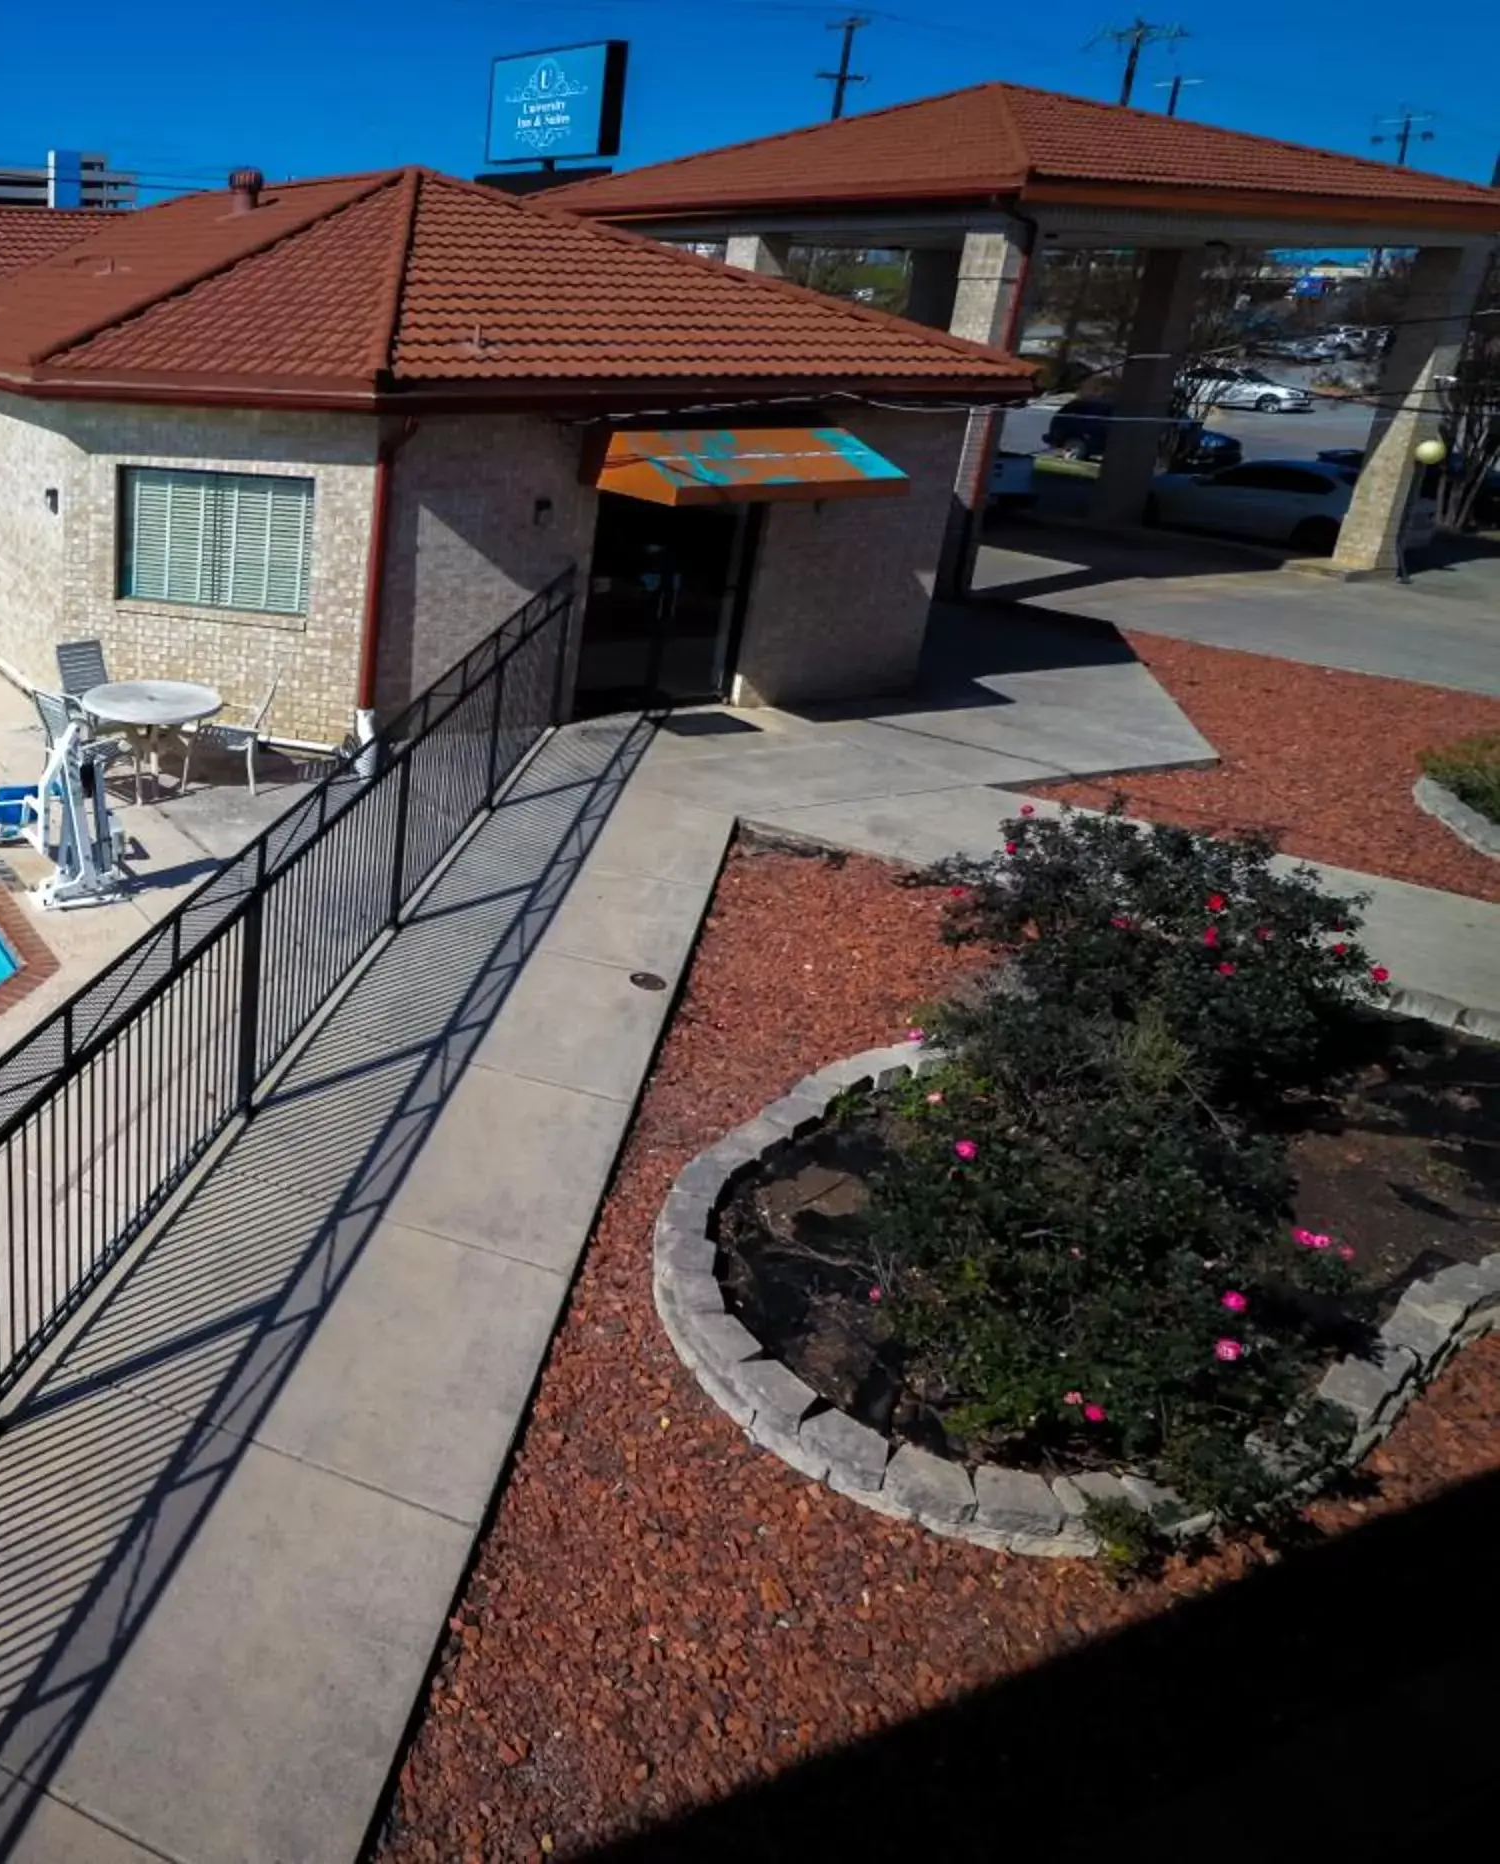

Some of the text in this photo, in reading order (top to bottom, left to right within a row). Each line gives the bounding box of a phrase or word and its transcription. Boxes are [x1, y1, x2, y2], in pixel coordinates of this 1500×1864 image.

[523, 100, 565, 114] University
[517, 116, 533, 128] Inn
[544, 114, 570, 124] Suites
